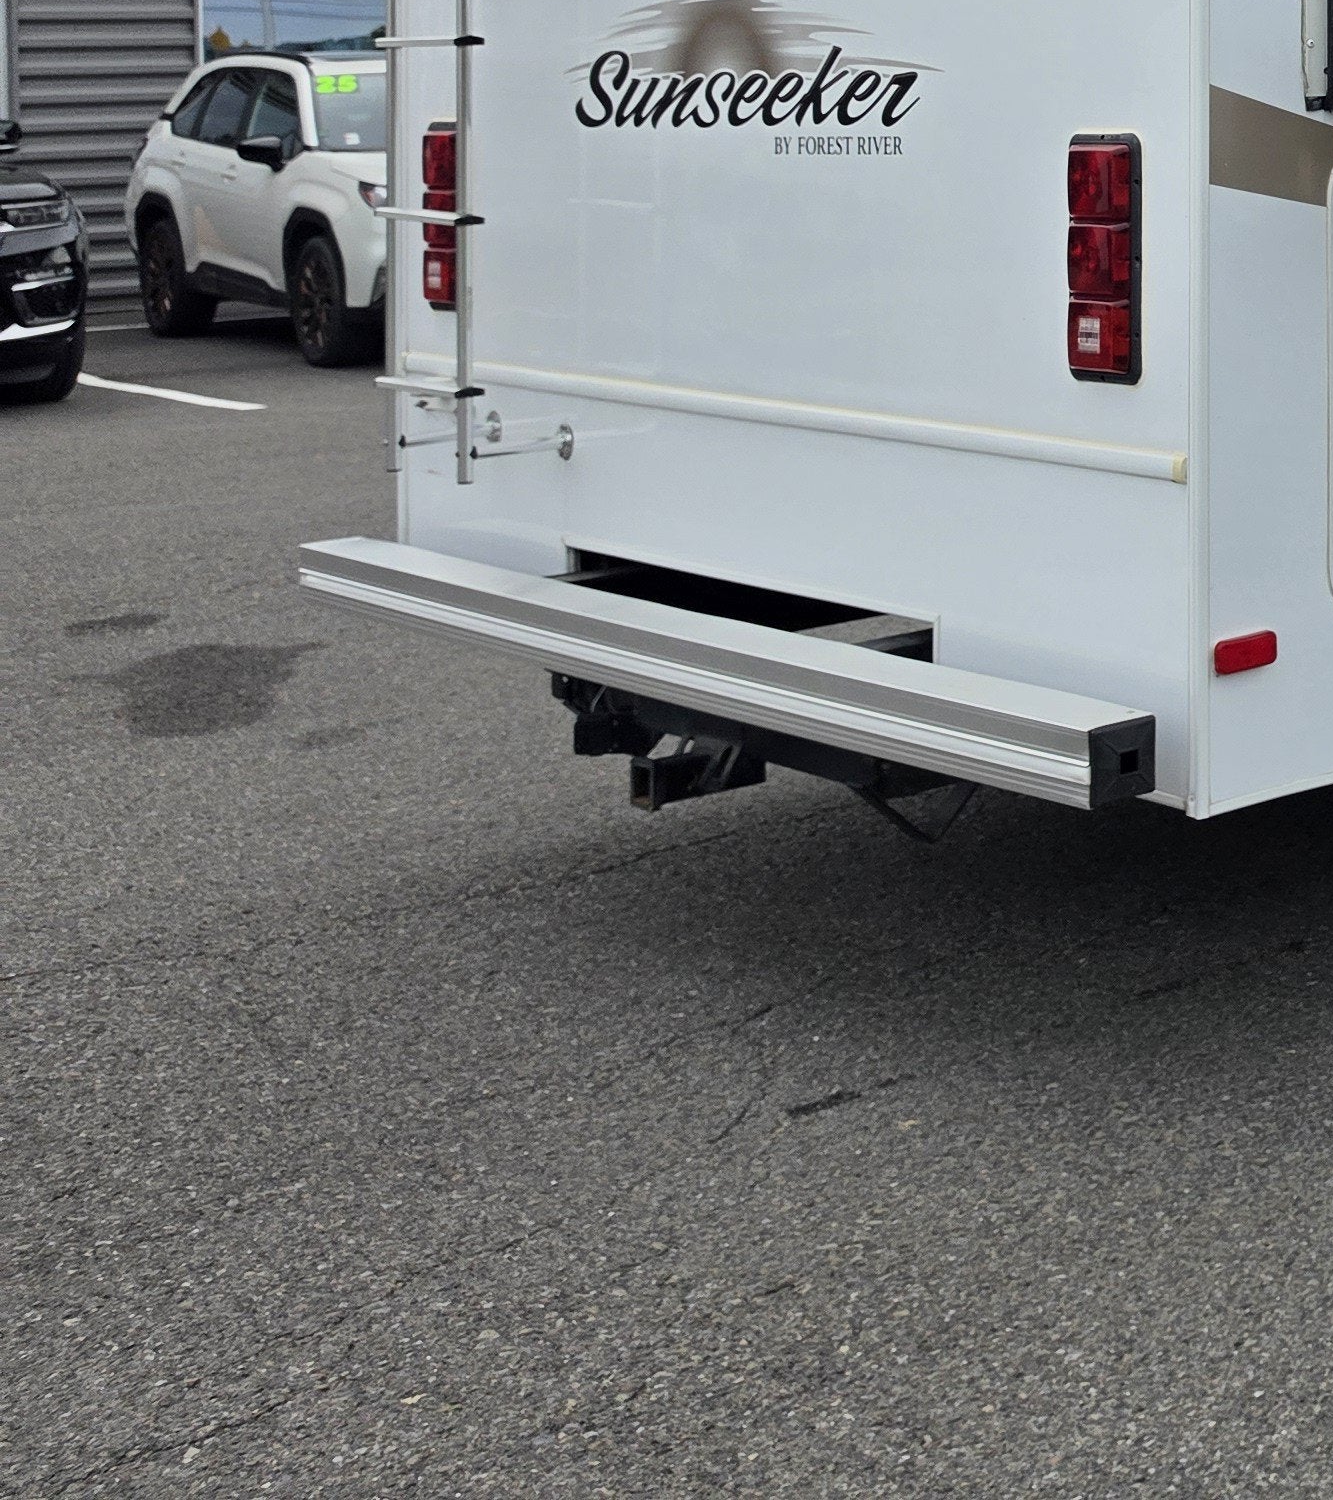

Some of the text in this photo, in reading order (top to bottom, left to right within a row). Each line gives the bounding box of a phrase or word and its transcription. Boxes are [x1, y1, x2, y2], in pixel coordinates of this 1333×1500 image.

[316, 74, 358, 94] 25
[574, 45, 921, 129] Sunseeker
[774, 136, 903, 155] BY FOREST RIVER
